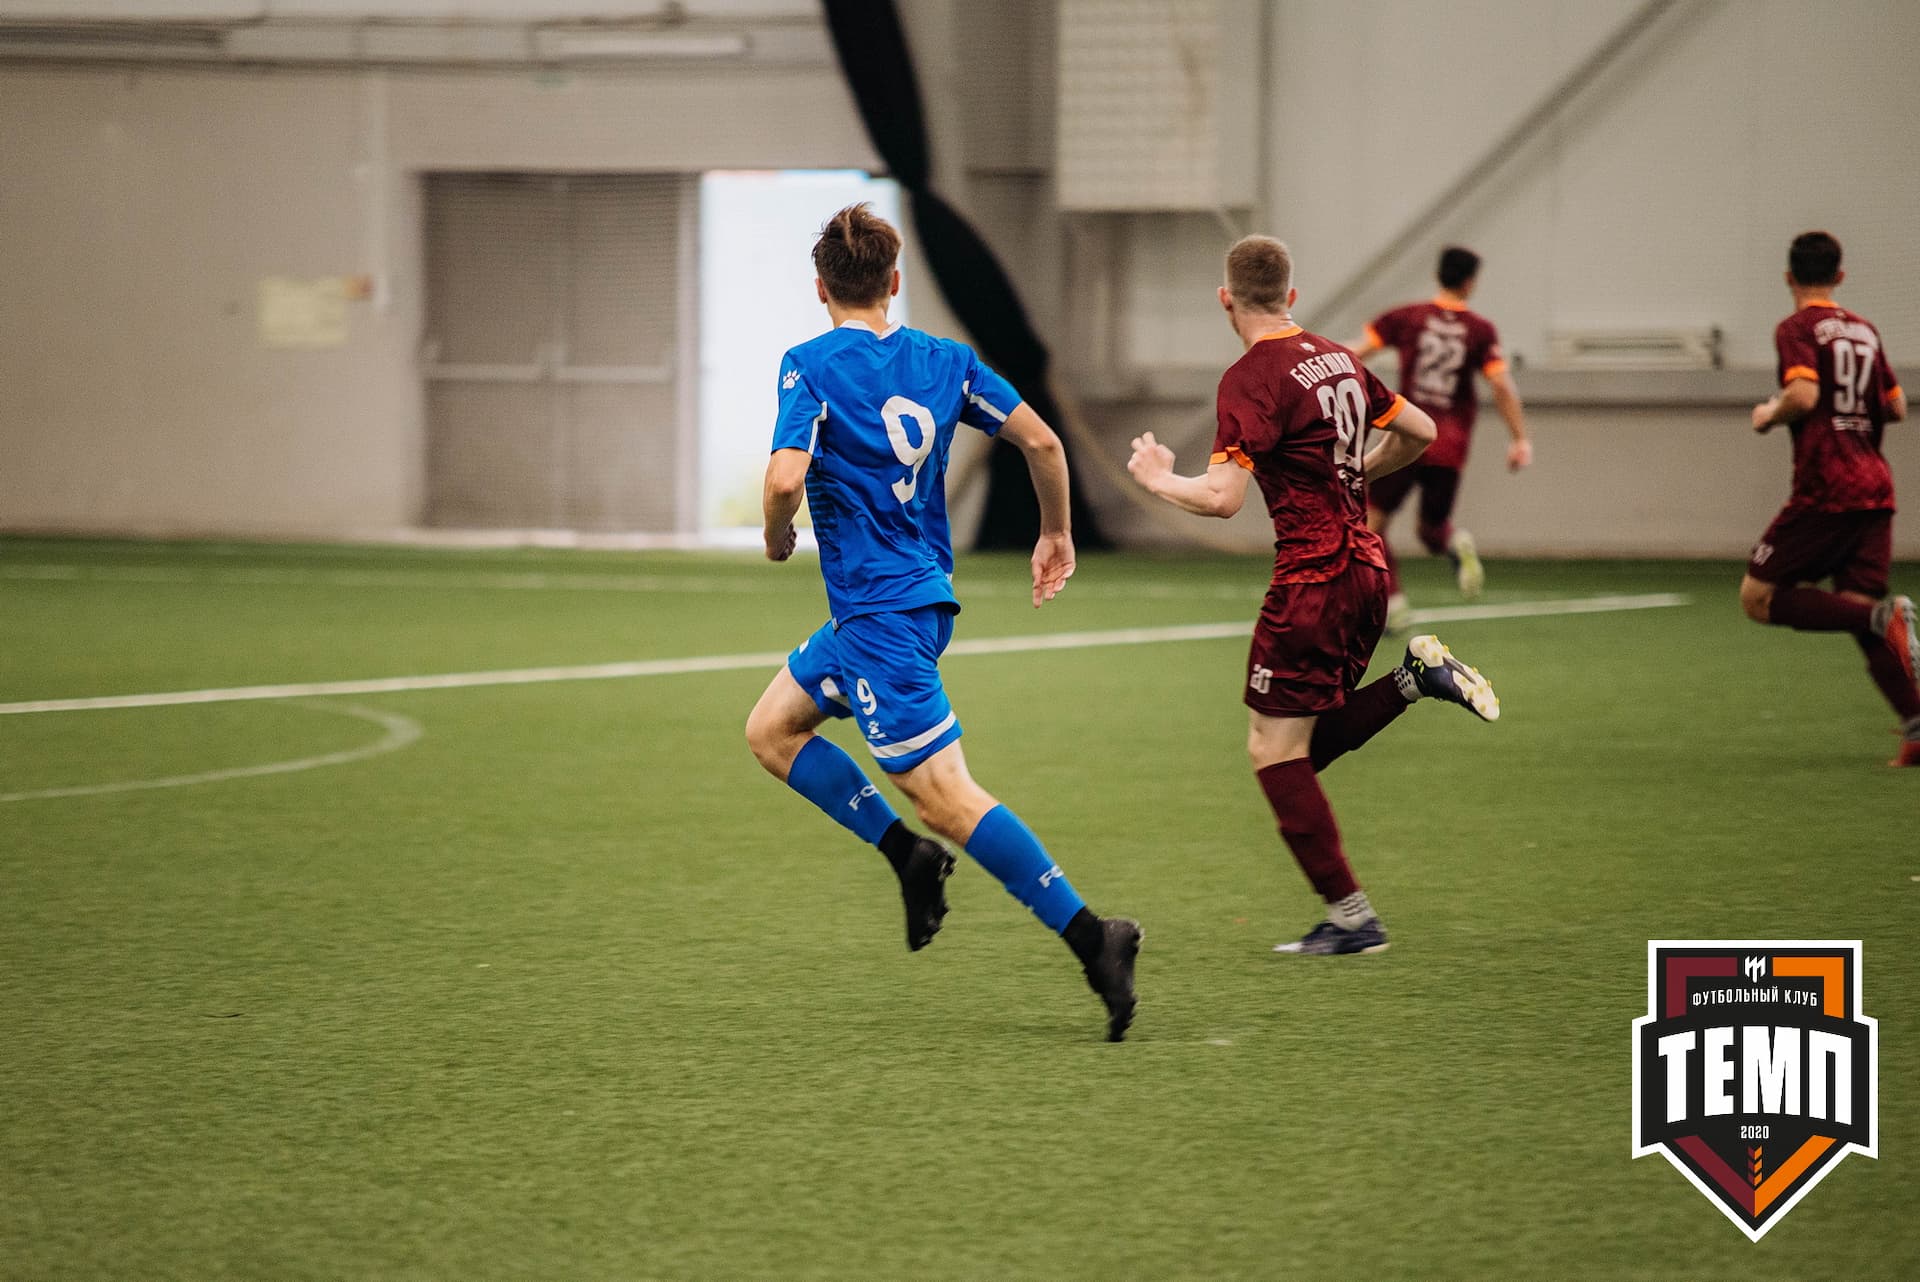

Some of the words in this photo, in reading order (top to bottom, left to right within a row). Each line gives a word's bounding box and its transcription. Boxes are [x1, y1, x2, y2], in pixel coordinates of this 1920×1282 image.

[1415, 331, 1466, 391] 22
[1832, 338, 1875, 415] 97
[881, 395, 936, 504] 9
[1316, 377, 1366, 472] 20
[857, 678, 877, 716] 9
